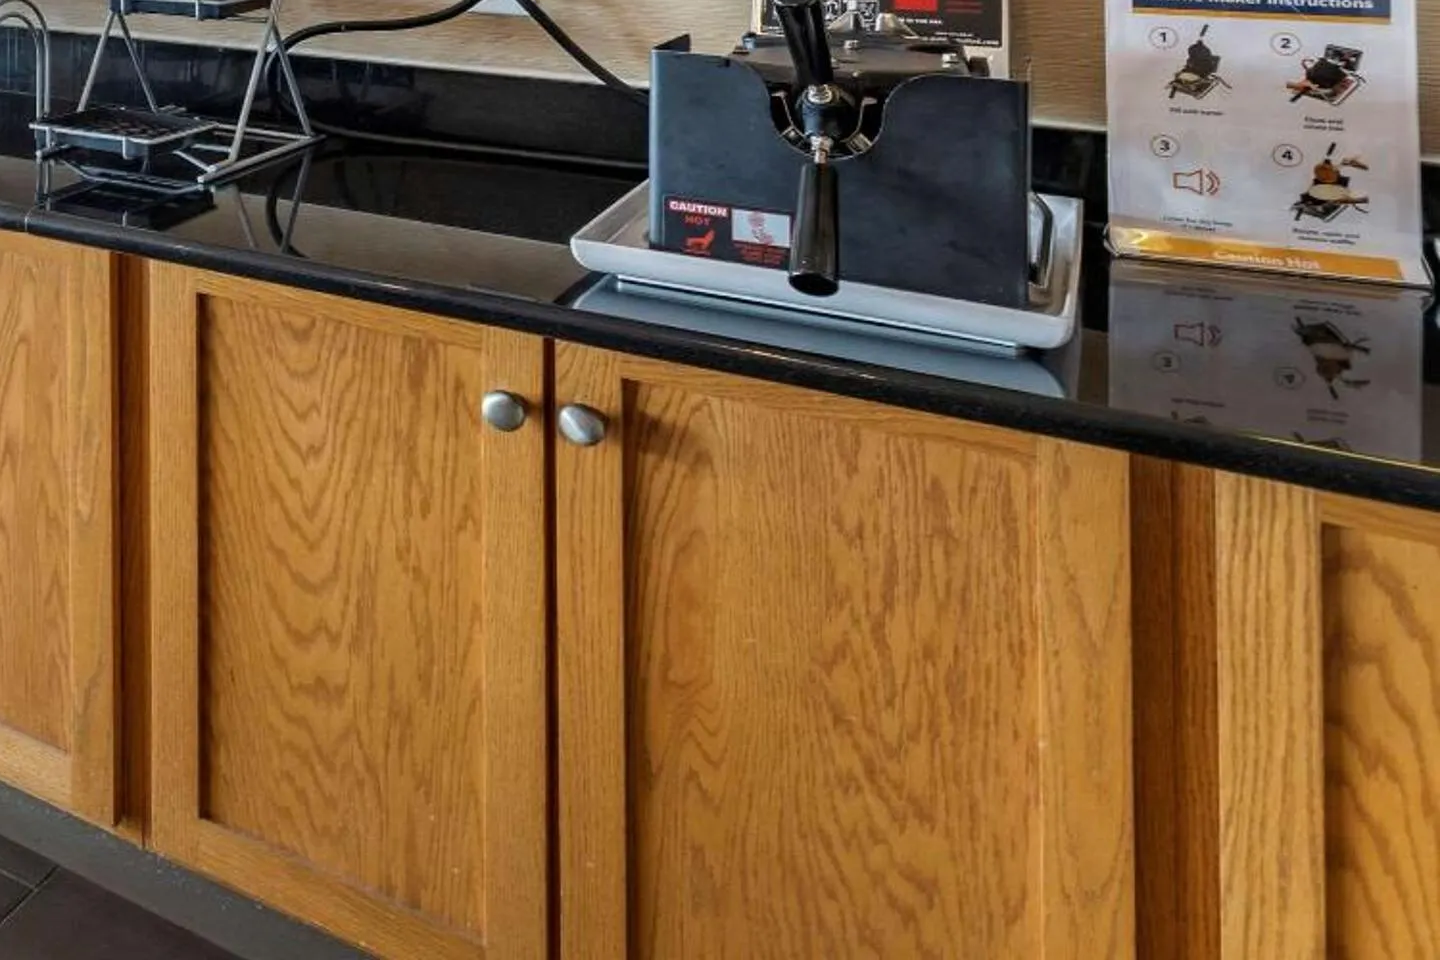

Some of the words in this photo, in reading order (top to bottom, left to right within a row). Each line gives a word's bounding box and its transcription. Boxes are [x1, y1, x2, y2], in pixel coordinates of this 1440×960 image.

[1279, 37, 1291, 49] 2
[1159, 139, 1171, 153] 3
[1282, 150, 1294, 162] 4
[668, 199, 729, 218] CAUTION
